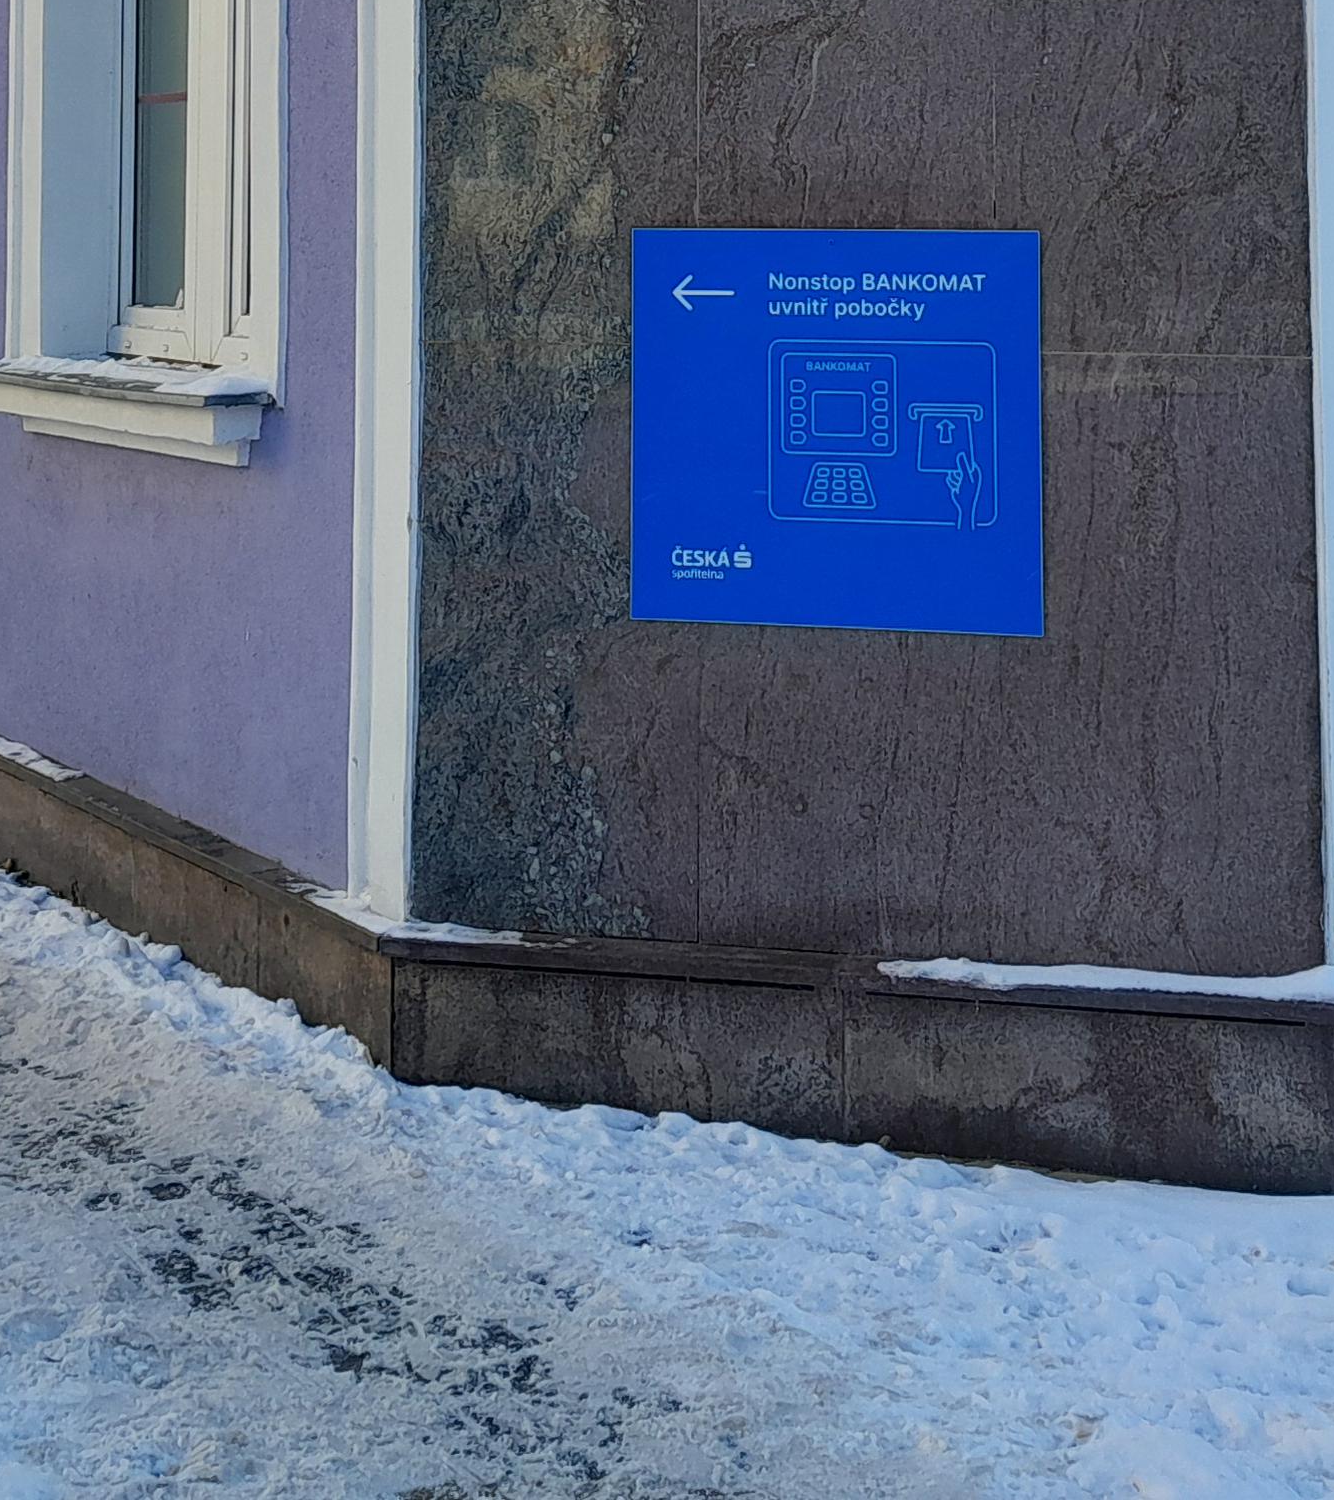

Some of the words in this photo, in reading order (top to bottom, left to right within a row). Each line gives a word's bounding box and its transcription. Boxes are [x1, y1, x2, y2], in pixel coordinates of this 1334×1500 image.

[768, 272, 856, 294] Nonstop
[862, 273, 986, 292] BANKOMAT
[768, 297, 829, 316] uvnitř
[834, 298, 925, 321] pobočky
[805, 360, 872, 372] BANKOMAT
[671, 545, 730, 568] ČESKÁ
